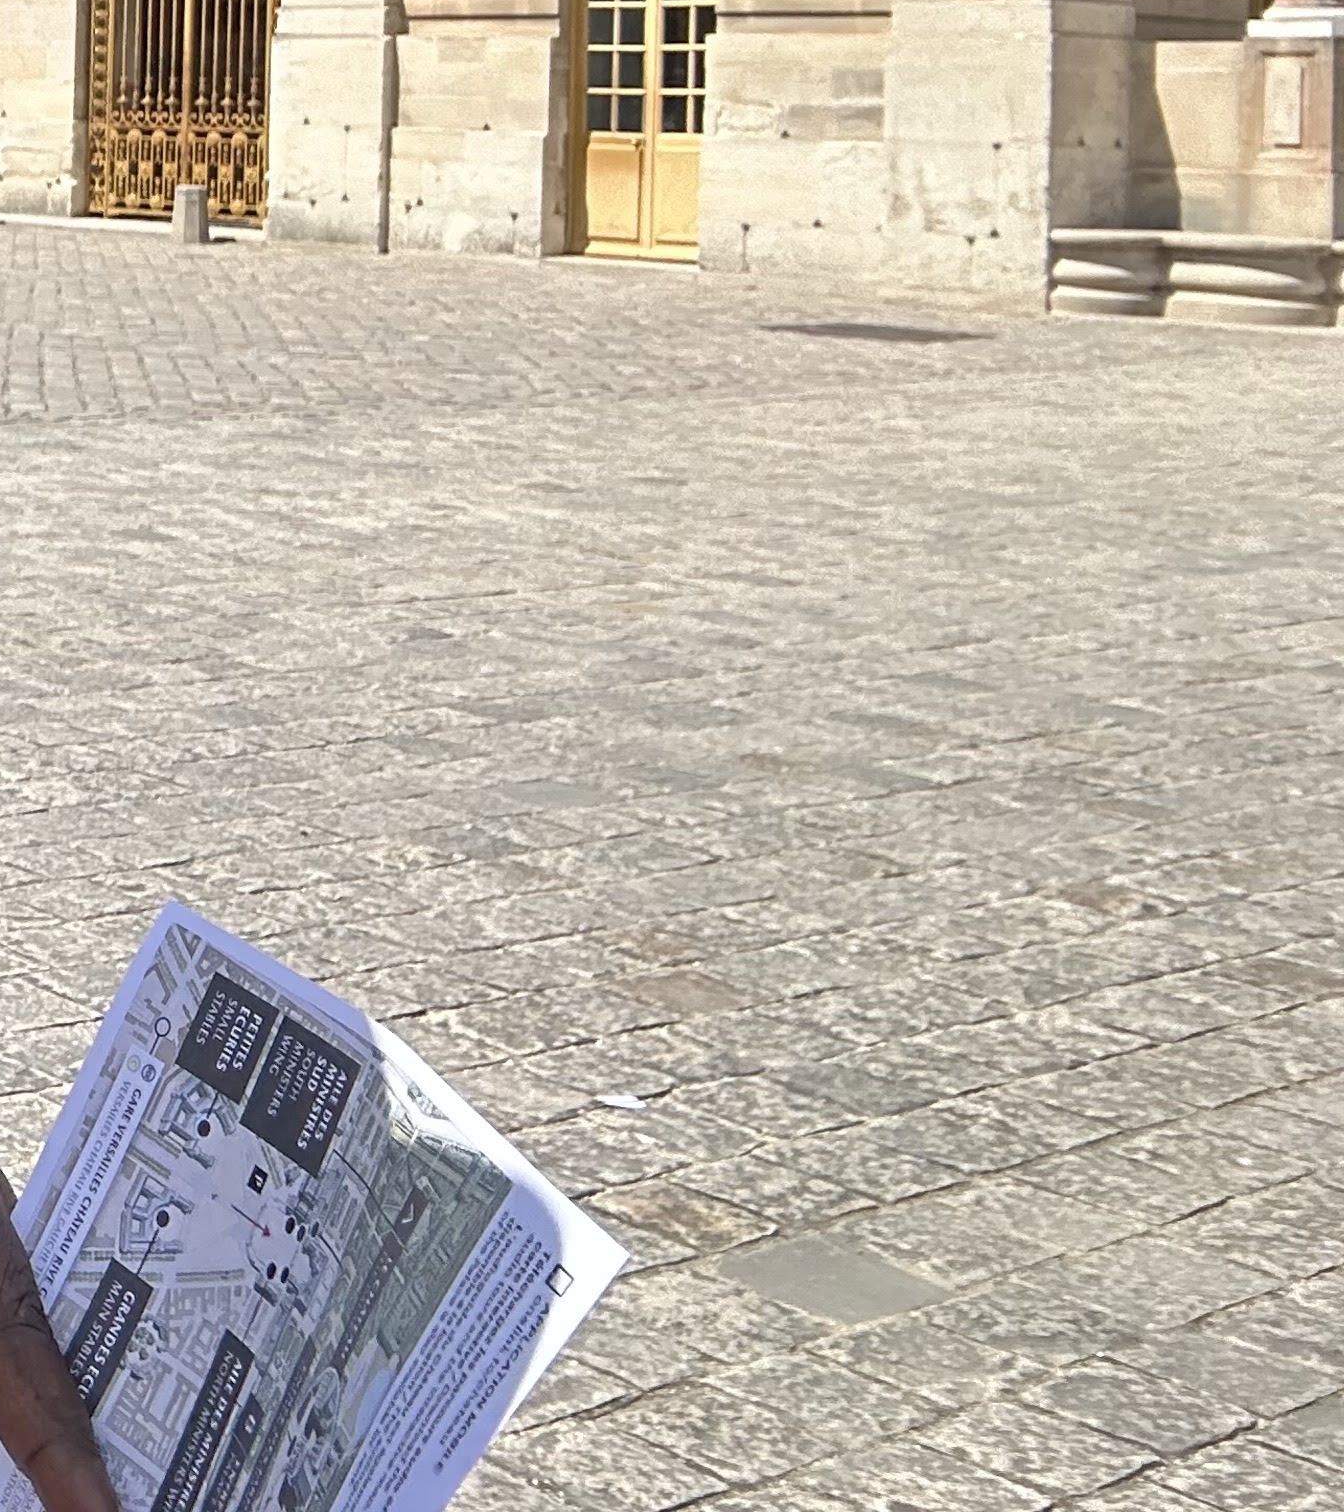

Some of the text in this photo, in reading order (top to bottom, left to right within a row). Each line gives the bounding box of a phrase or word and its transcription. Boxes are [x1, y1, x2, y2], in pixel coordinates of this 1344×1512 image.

[194, 990, 226, 1046] STABLES
[211, 997, 238, 1042] SMALL
[215, 1005, 251, 1072] ECURIES
[232, 1013, 263, 1071] PETITES
[266, 1041, 304, 1117] MINISTERS
[267, 1033, 293, 1076] WING
[287, 1048, 316, 1101] SOUTH
[306, 1055, 327, 1093] SUD
[98, 1079, 131, 1138] VERSAILLES
[120, 1088, 142, 1123] GARE
[296, 1063, 338, 1150] MINISTRES
[313, 1069, 349, 1141] AILE DES
[87, 1124, 126, 1194] VERSAILLES
[43, 1255, 63, 1285] RIVE
[68, 1280, 123, 1377] MAIN STABLES
[93, 1290, 136, 1365] GRANDES
